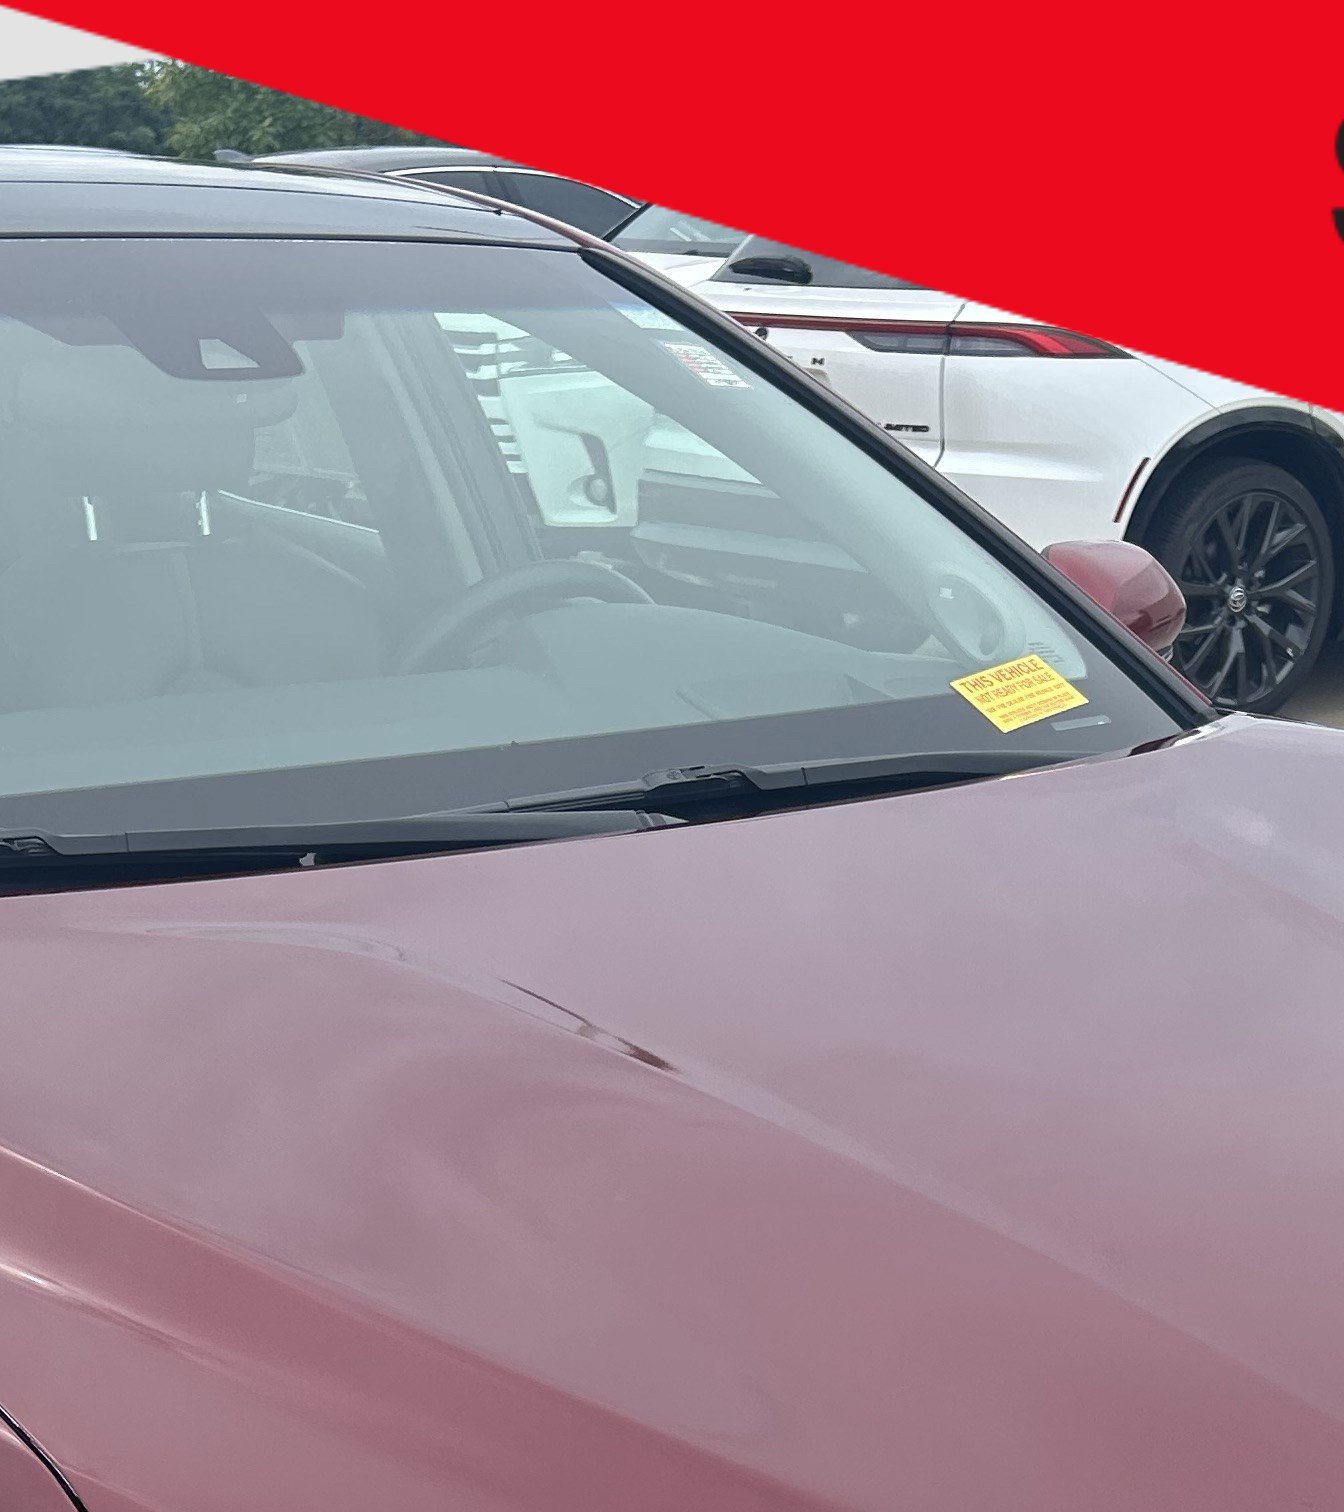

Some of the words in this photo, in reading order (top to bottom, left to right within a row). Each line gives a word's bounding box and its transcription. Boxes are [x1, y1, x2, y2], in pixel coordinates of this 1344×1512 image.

[959, 674, 994, 693] THIS
[991, 658, 1044, 683] VEHICLE
[975, 690, 995, 704] NOT
[992, 683, 1018, 699] READY
[1016, 678, 1035, 689] FOR
[1033, 672, 1055, 685] SALE
